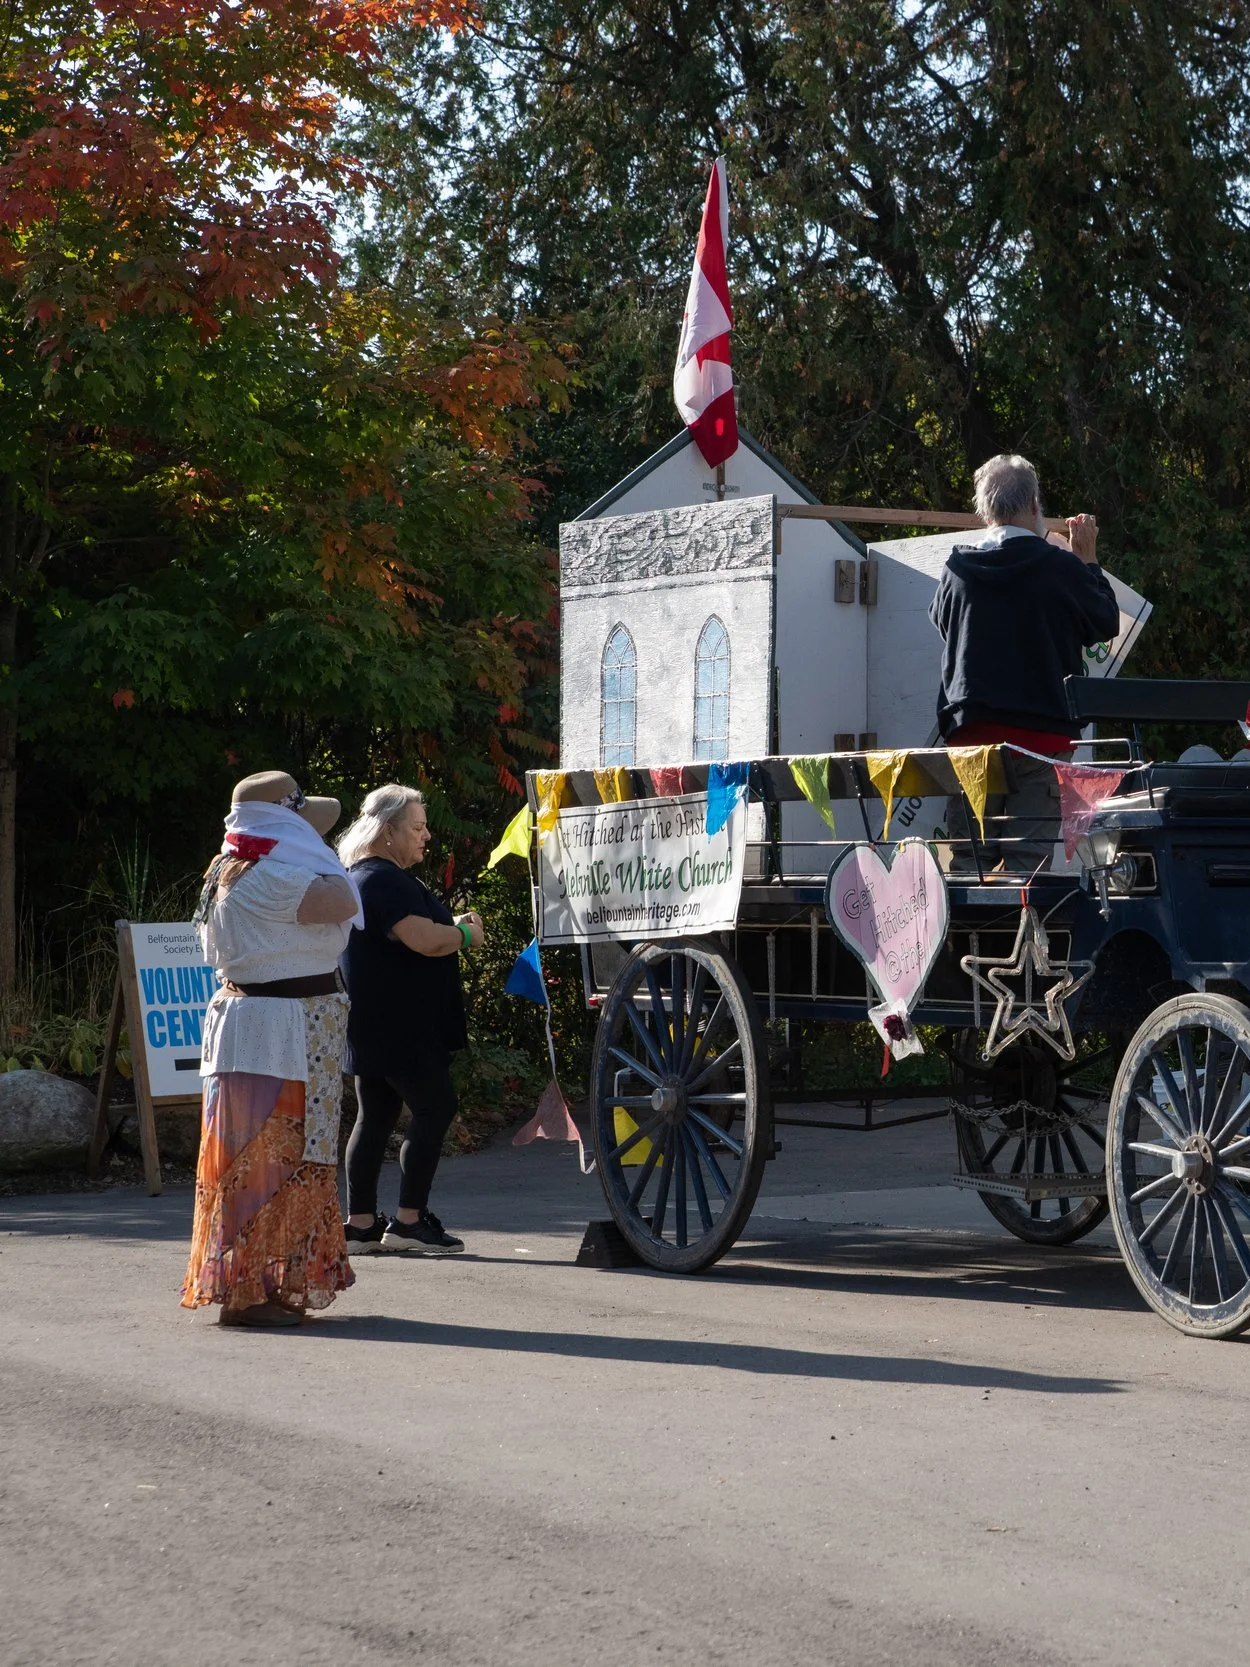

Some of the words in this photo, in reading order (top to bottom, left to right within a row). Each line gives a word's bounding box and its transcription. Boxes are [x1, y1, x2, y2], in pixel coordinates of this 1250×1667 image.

[573, 814, 627, 848] Hitched
[651, 811, 672, 840] the
[678, 846, 733, 893] Church
[843, 875, 877, 920] Get
[869, 876, 930, 949] Hitched
[147, 934, 195, 944] Belfountain
[163, 944, 194, 955] Society
